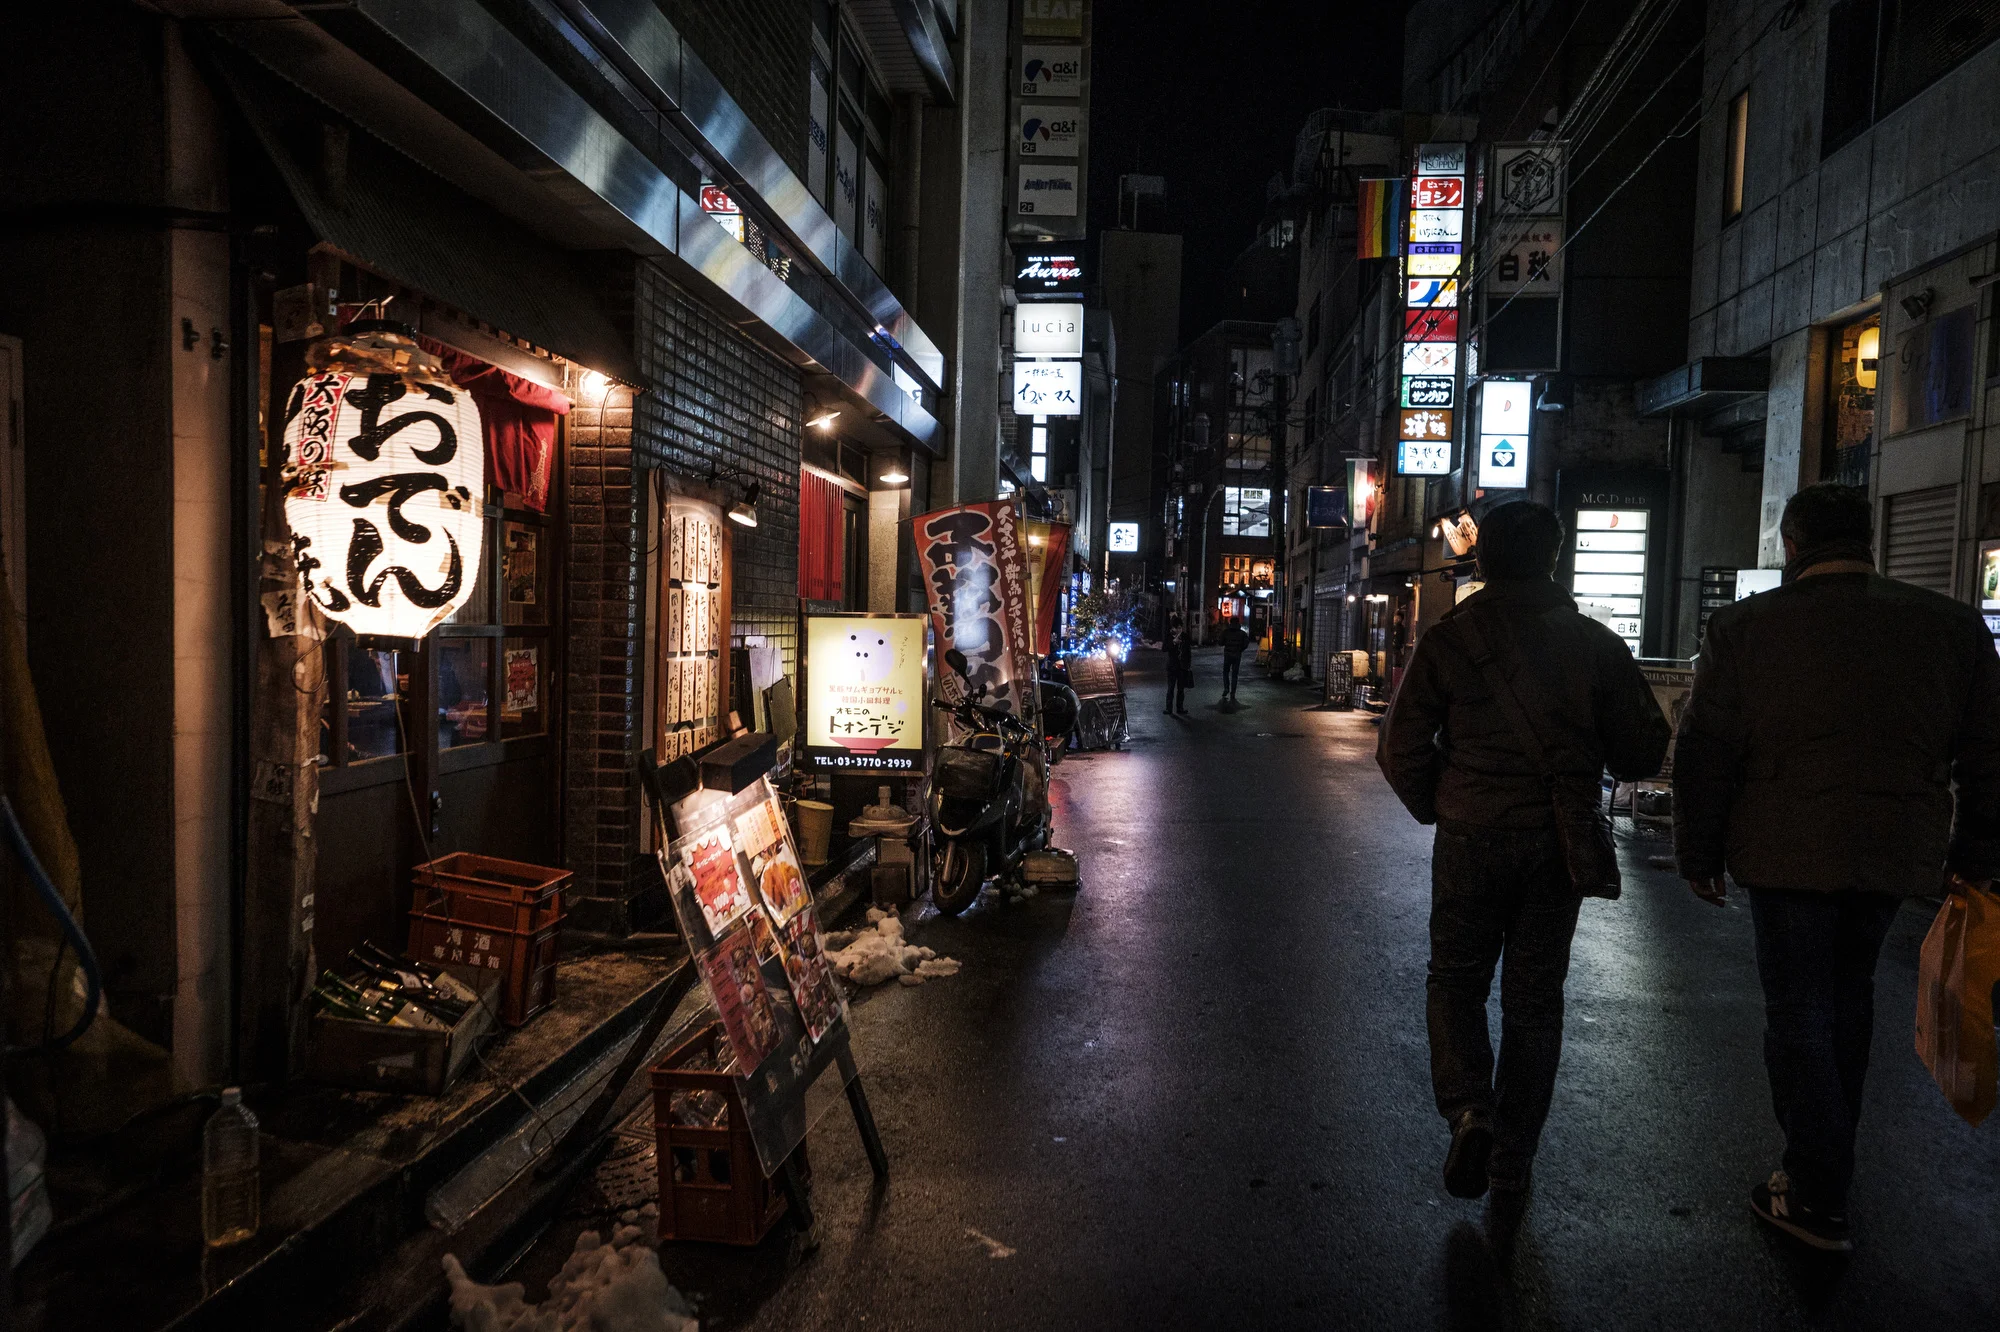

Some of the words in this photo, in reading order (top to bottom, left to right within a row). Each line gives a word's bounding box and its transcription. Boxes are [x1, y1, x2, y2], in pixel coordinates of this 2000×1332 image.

[1022, 143, 1035, 152] 2F
[1427, 160, 1456, 169] SUPPLY
[1419, 190, 1460, 205] ヨシノ
[1021, 202, 1033, 212] 2F
[1498, 250, 1550, 282] 白秋
[1021, 319, 1075, 333] lucia
[1411, 389, 1450, 403] サングリア
[302, 374, 334, 497] 大阪の味
[339, 373, 470, 609] おでん
[1582, 493, 1619, 504] M.C.D
[1624, 497, 1646, 505] BLD
[1617, 622, 1638, 634] 白秋
[836, 707, 870, 716] オモニの
[829, 715, 905, 736] トォンデジ
[814, 756, 913, 769] TEL:03-3770-2939
